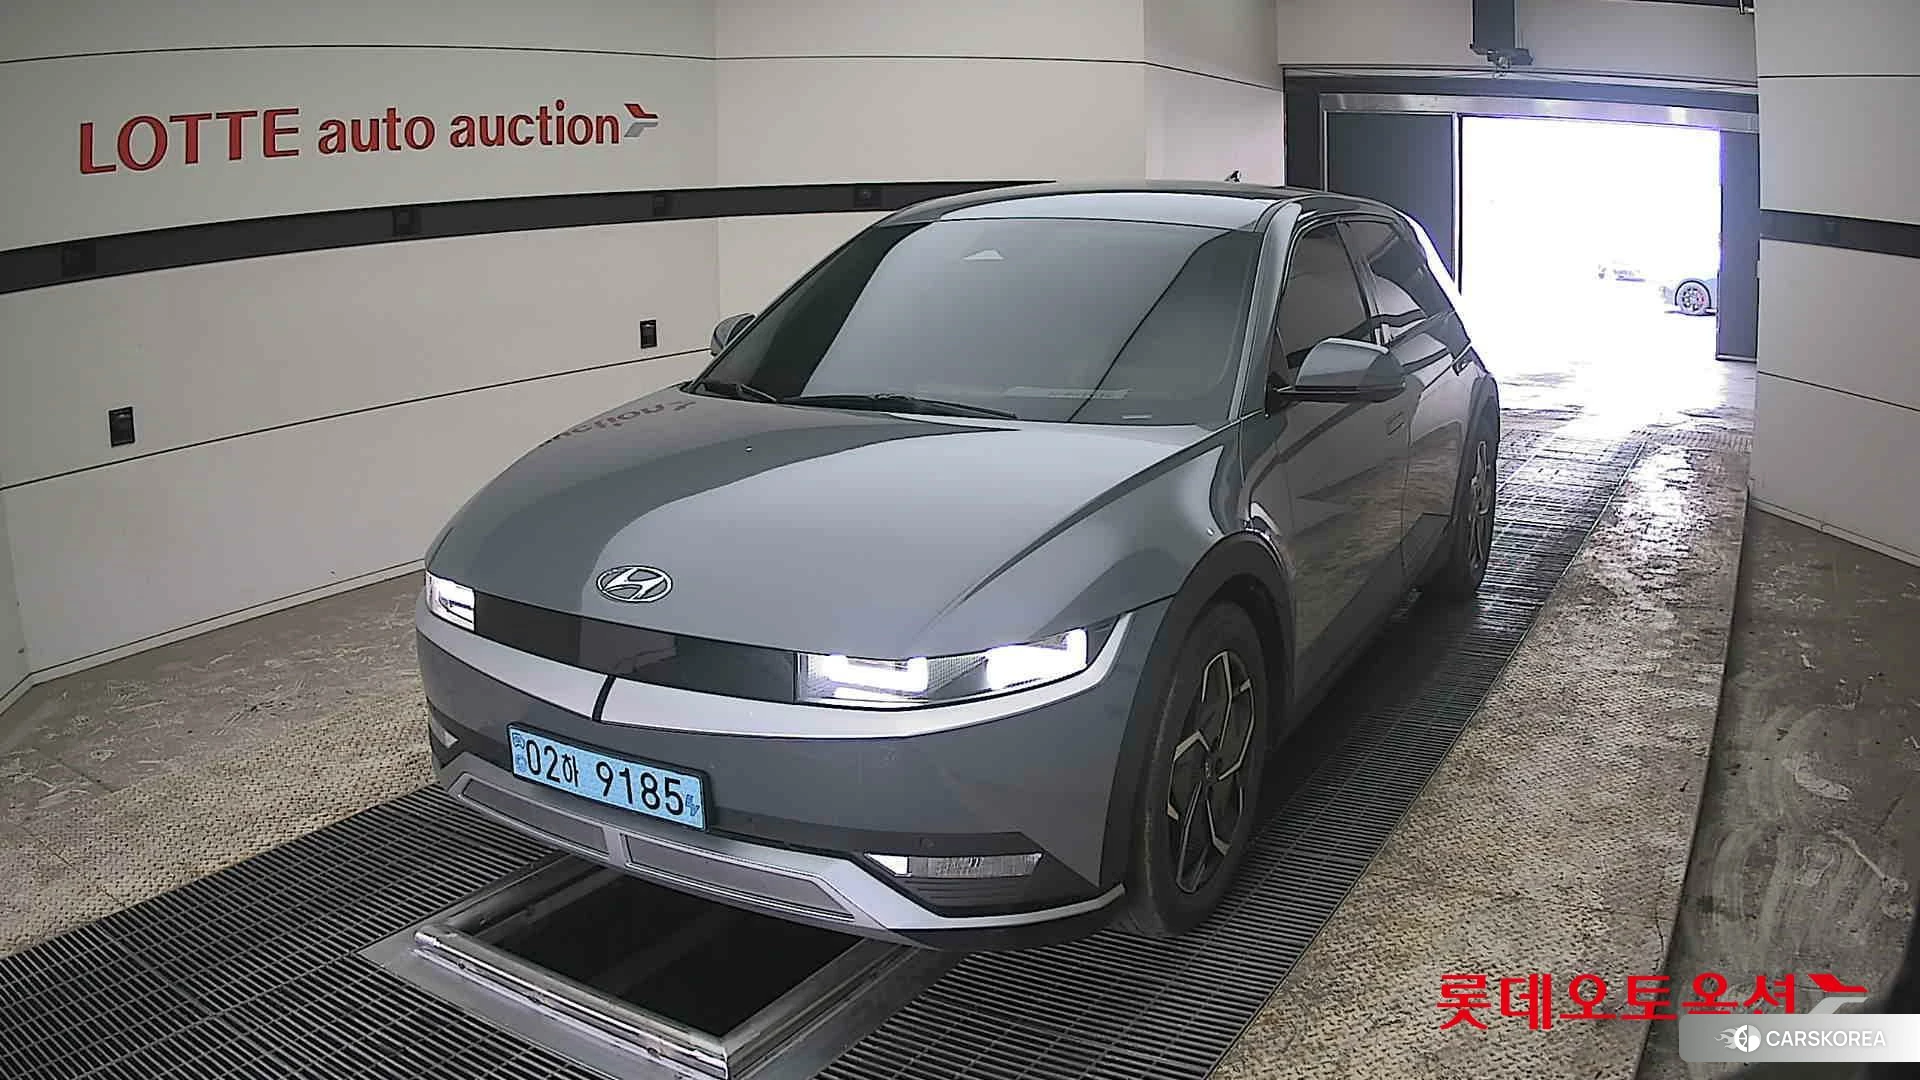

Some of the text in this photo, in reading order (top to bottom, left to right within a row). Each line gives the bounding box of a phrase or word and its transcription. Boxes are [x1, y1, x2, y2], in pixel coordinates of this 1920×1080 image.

[79, 99, 620, 175] LOTTE auto auction
[525, 739, 684, 816] 02하 9185
